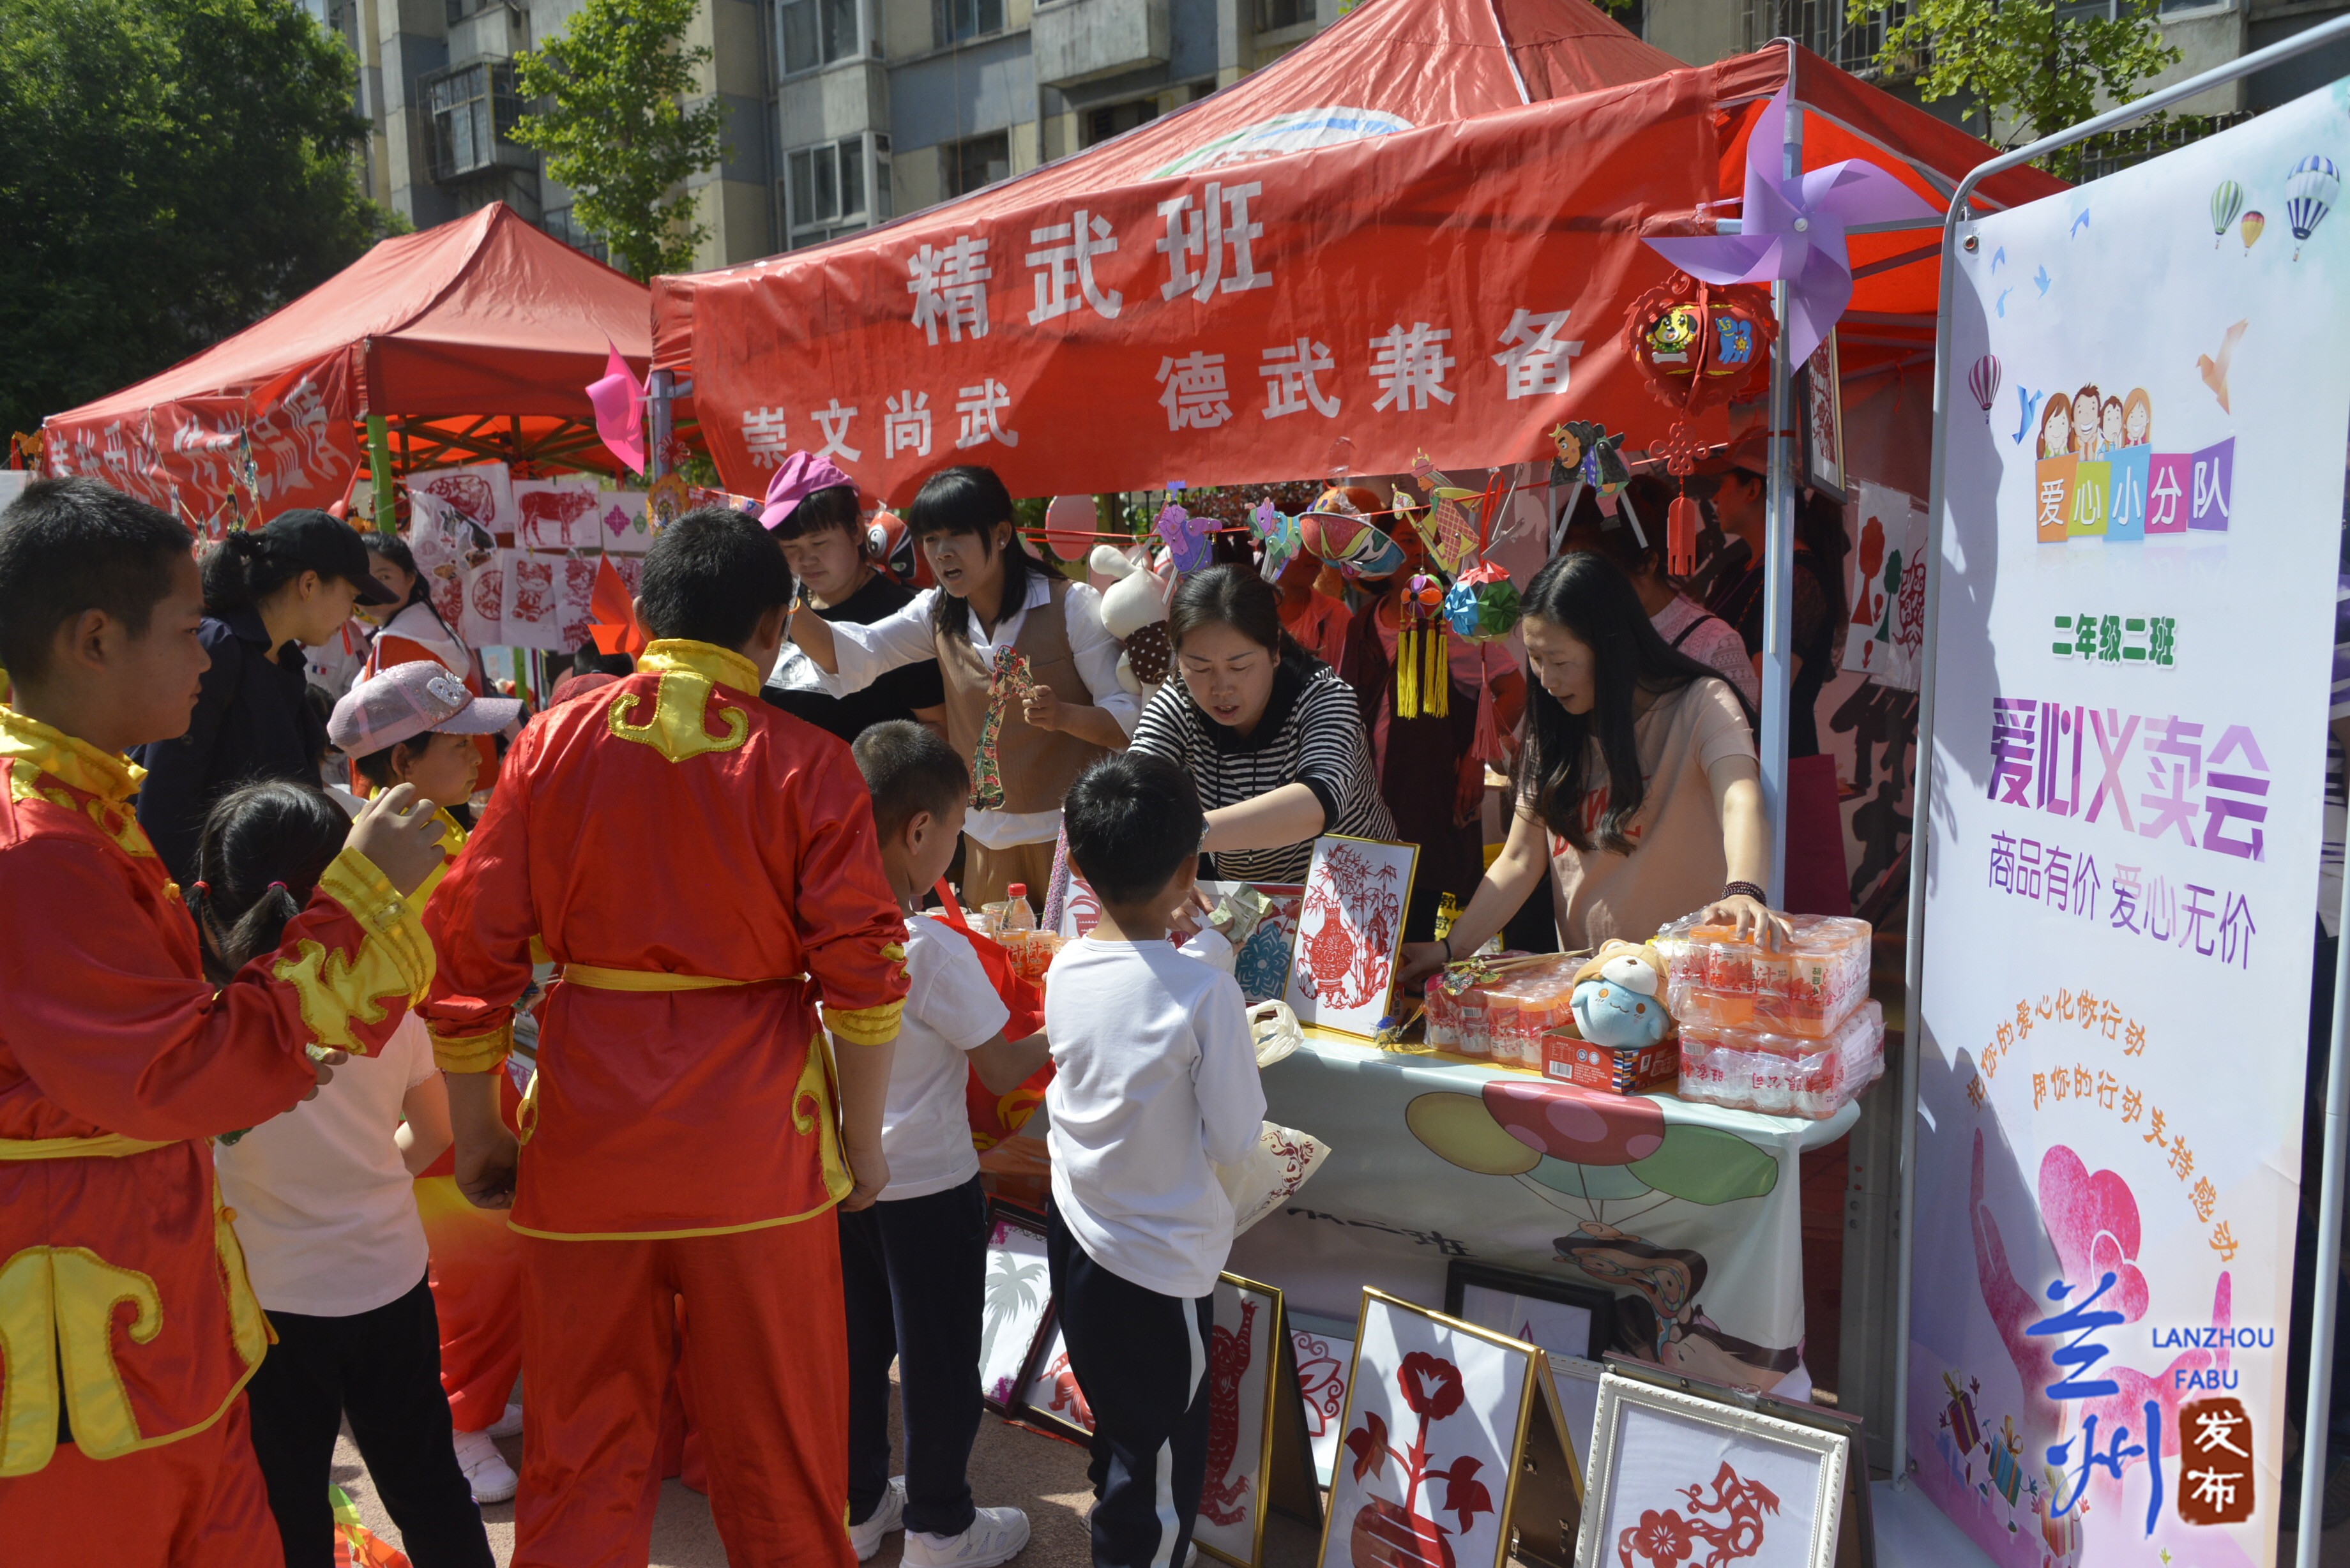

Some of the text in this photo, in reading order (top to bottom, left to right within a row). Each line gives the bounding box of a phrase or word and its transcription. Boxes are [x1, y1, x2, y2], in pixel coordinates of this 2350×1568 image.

[907, 180, 1273, 347] 精武班
[741, 377, 1019, 469] 崇文尚武
[1154, 308, 1585, 432] 德武兼备
[2039, 456, 2229, 526] 爱心小分队
[2051, 613, 2176, 668] 二年级二班
[1987, 697, 2271, 863] 爱心义卖会
[1989, 830, 2256, 970] 商品有价 爱心无价
[1966, 986, 2147, 1113] 把你的爱心化做行动
[2031, 1062, 2240, 1262] 用你的行动支持感动
